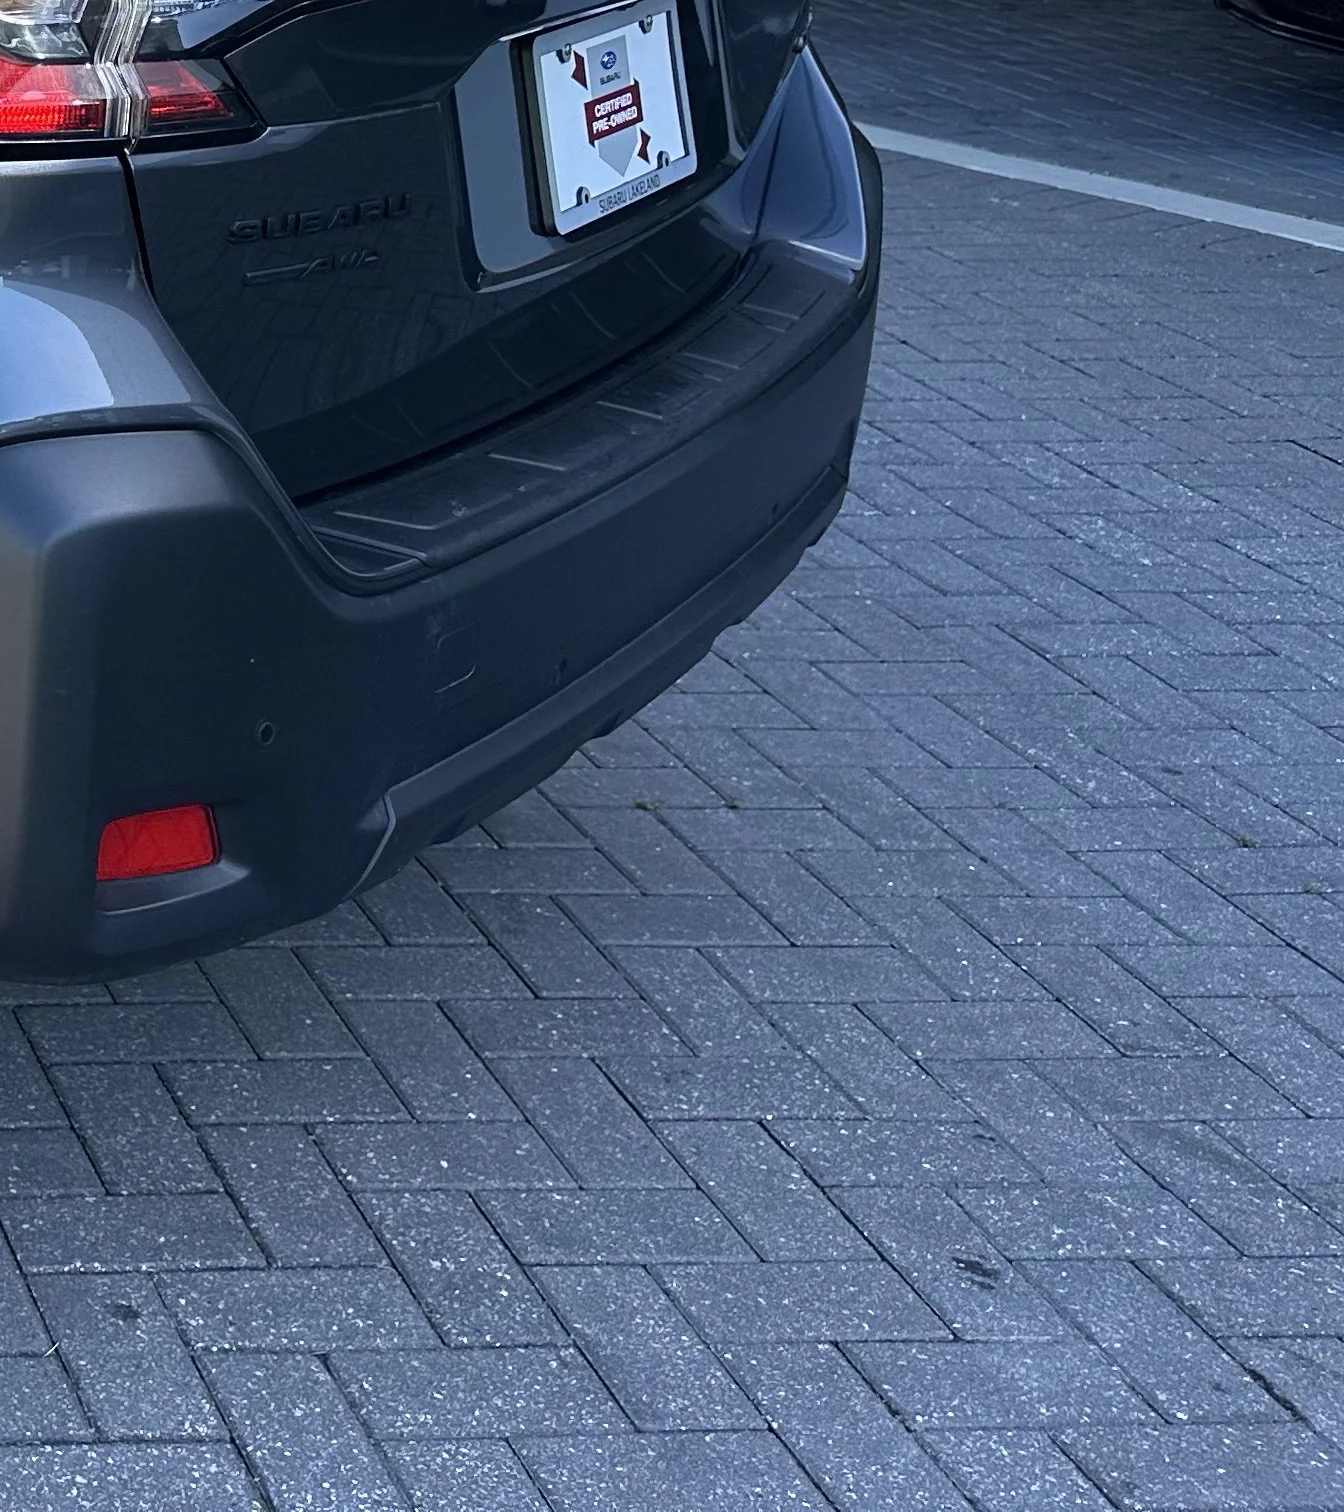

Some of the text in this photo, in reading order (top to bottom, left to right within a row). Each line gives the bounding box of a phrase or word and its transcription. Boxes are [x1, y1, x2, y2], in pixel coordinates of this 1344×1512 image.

[592, 106, 638, 134] PRE-OWNED
[594, 92, 633, 117] CERTIFIED
[598, 174, 661, 214] SUBARU LAKELAND
[226, 194, 411, 245] SUBARU
